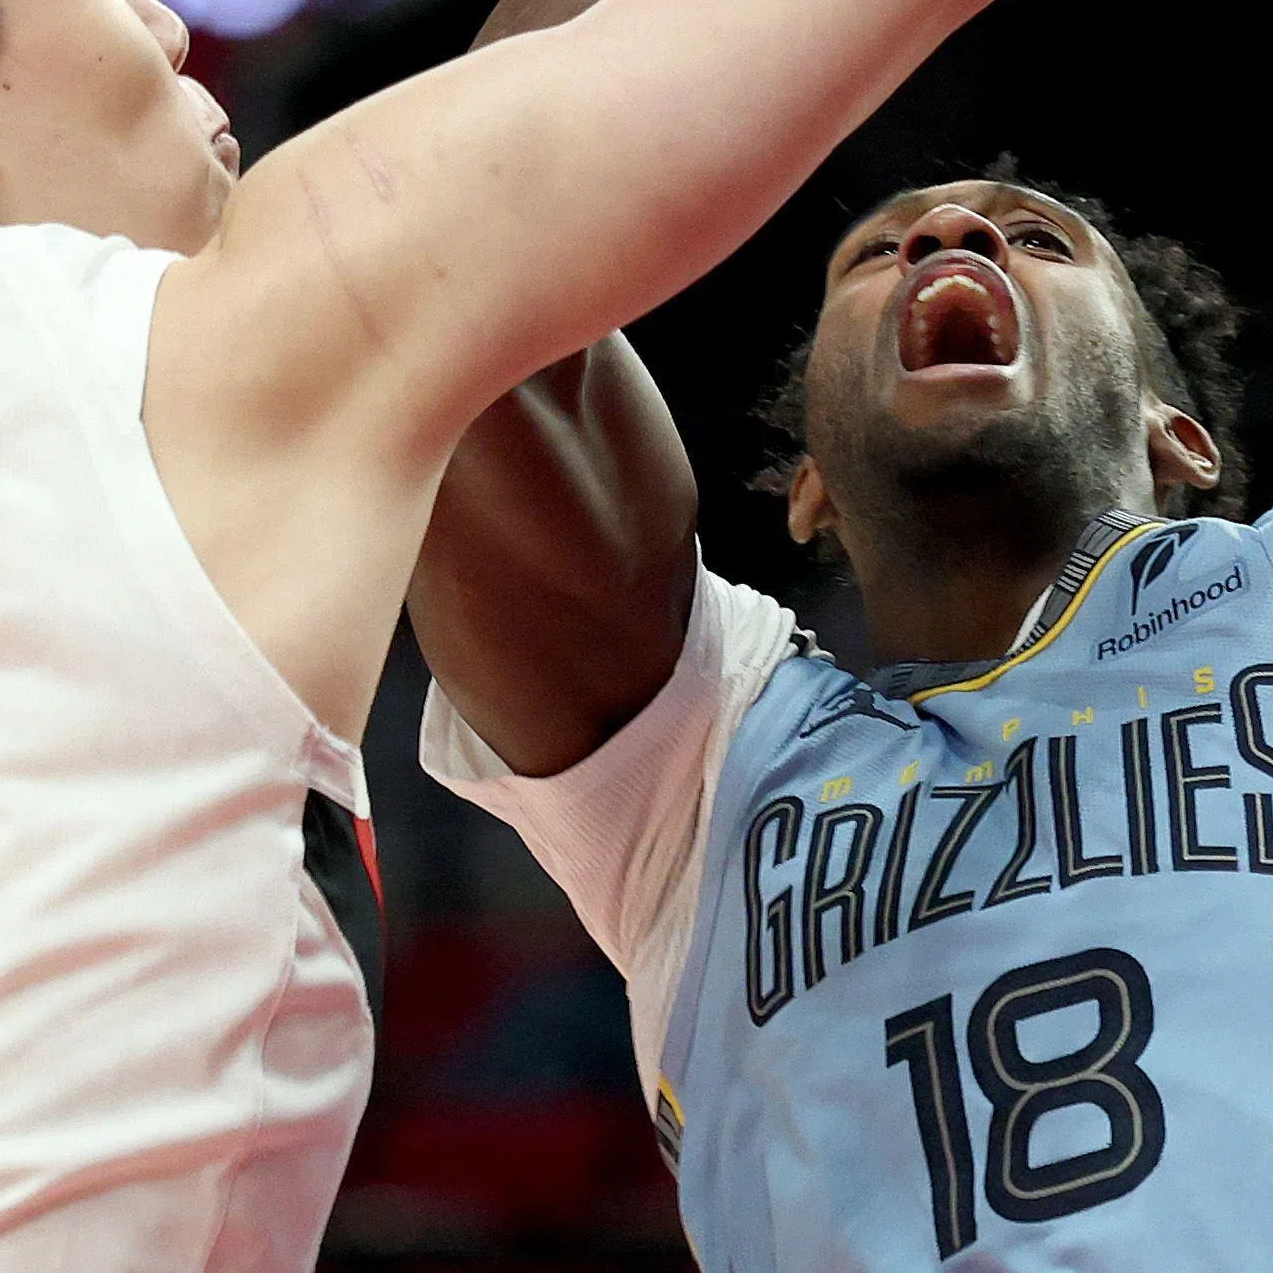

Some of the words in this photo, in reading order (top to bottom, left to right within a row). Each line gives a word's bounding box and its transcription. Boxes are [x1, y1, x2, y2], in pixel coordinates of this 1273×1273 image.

[1098, 565, 1243, 660] Robinhood
[819, 667, 1214, 803] MEMPHIS
[885, 948, 1165, 1260] 18
